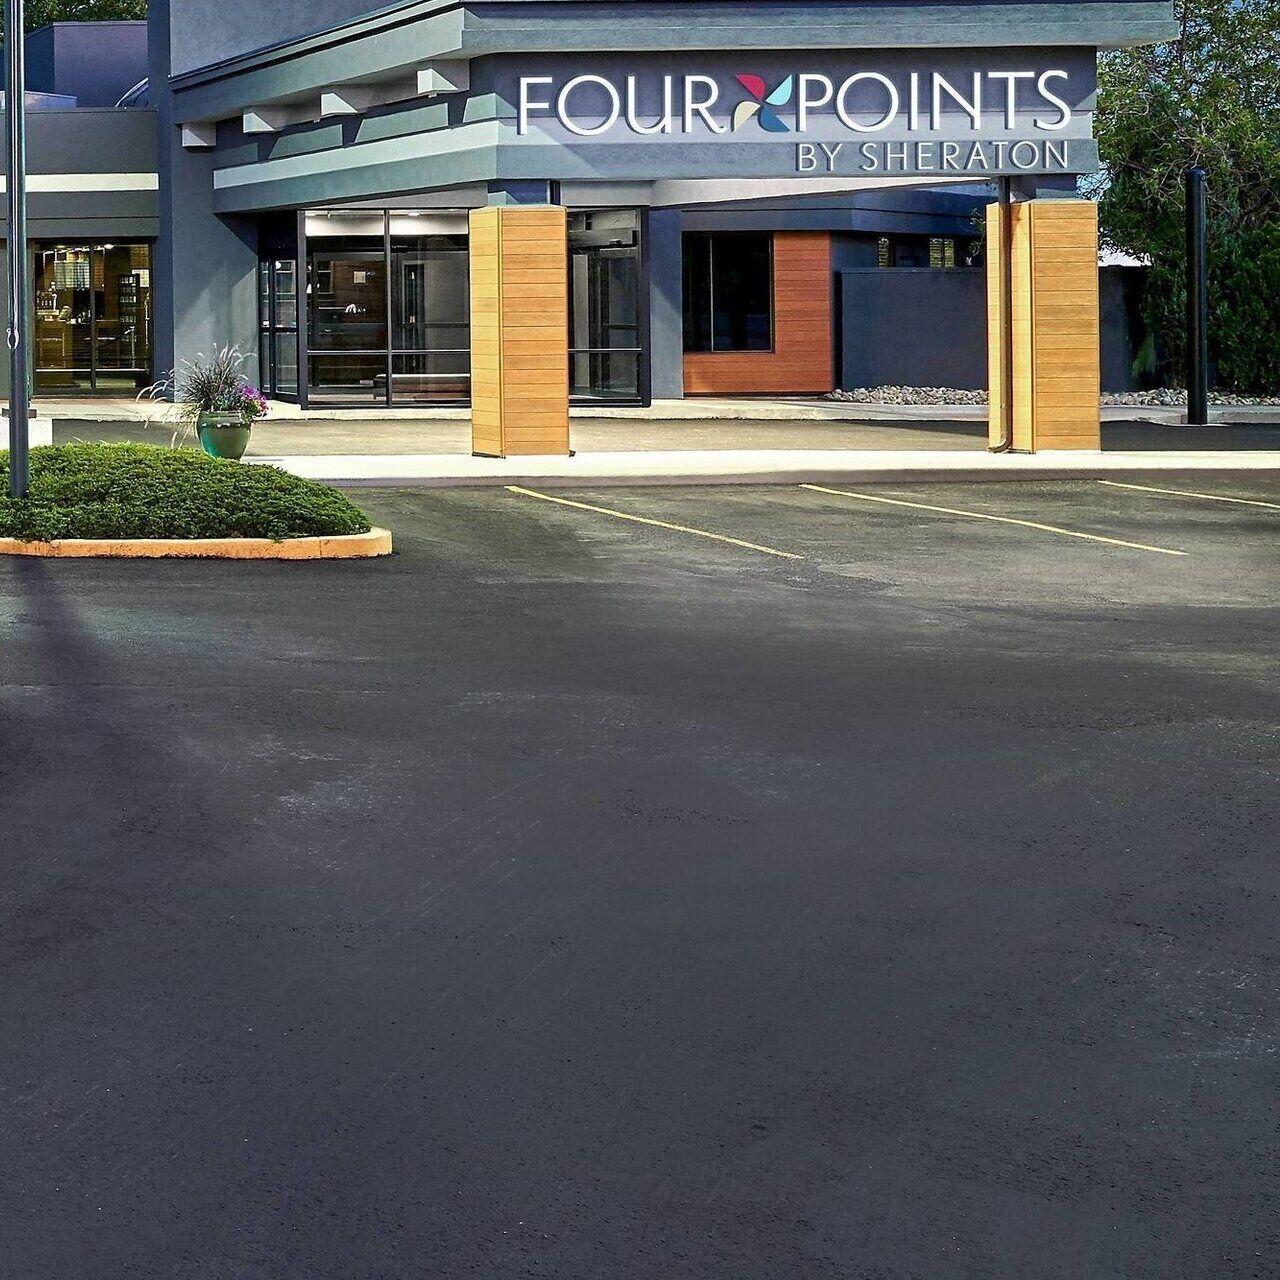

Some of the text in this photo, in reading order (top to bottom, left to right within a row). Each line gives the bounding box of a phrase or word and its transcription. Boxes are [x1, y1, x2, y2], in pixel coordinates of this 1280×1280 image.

[517, 70, 1072, 136] FOUR POINTS
[797, 141, 1069, 172] BY SHERATON
